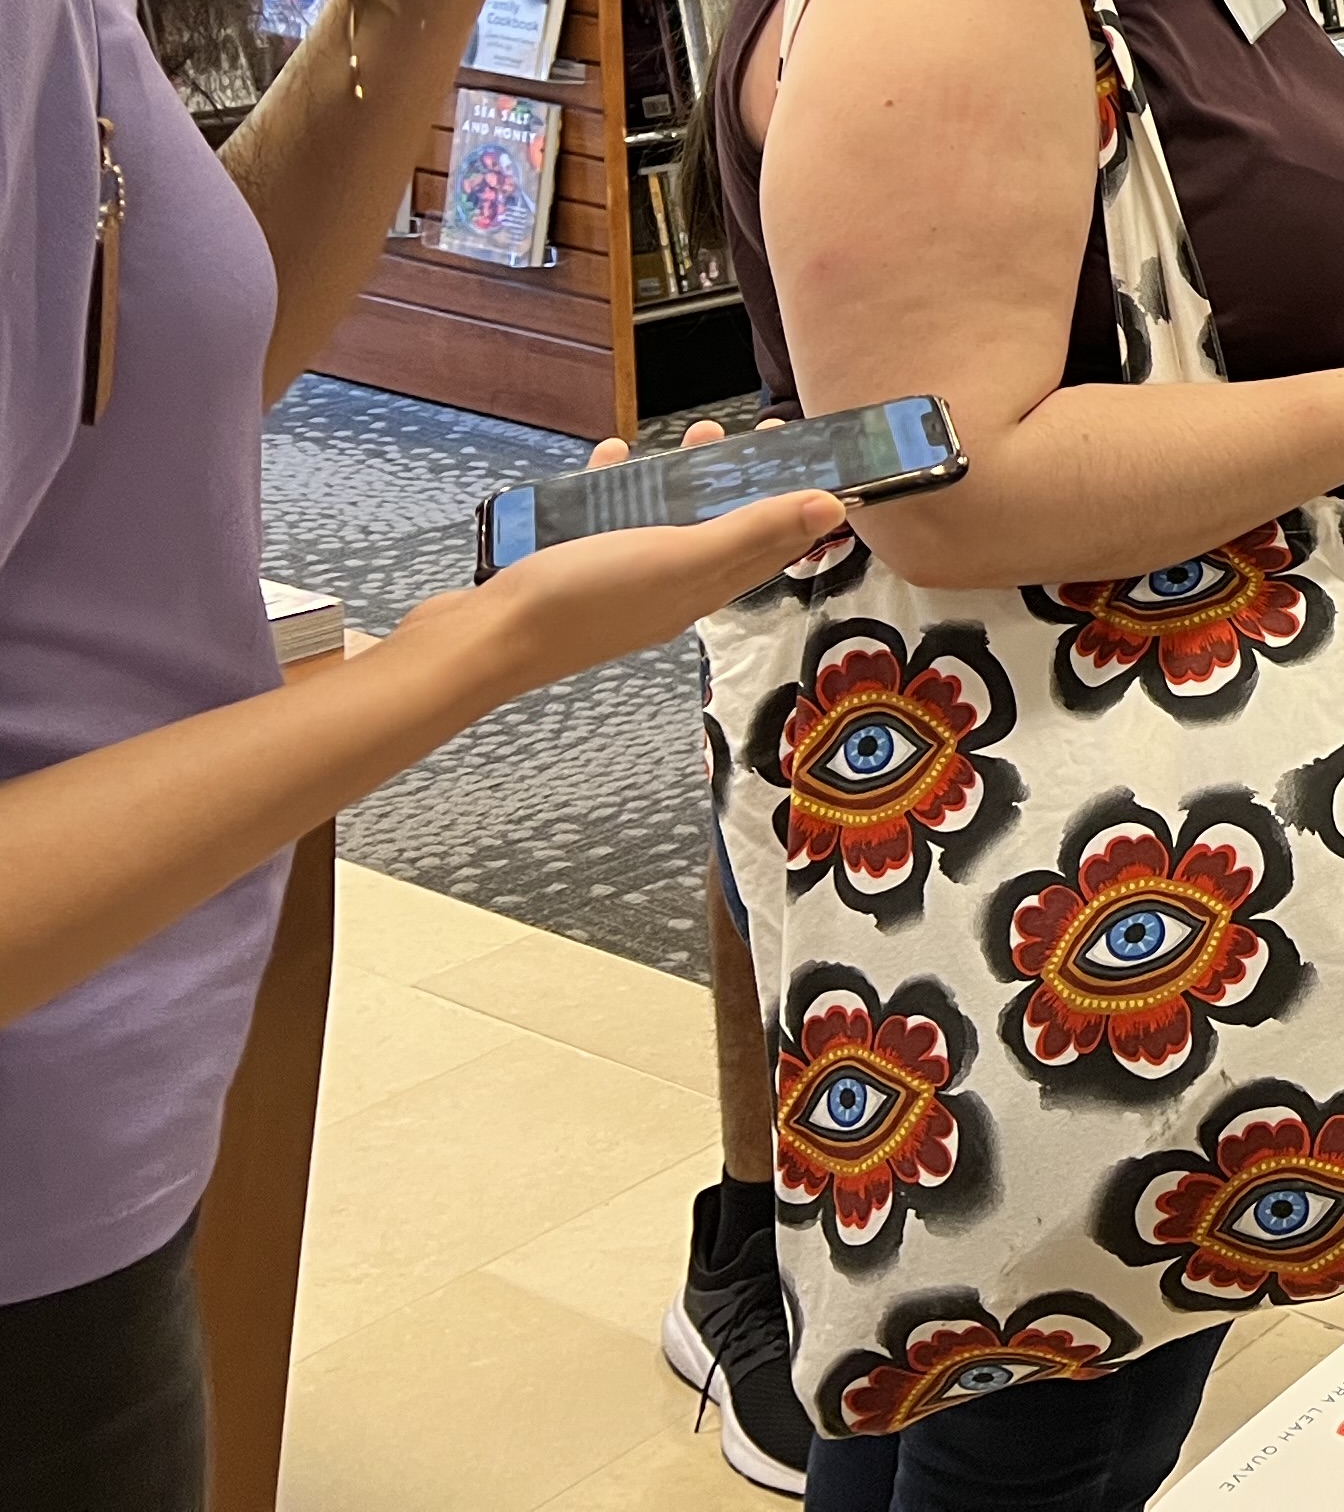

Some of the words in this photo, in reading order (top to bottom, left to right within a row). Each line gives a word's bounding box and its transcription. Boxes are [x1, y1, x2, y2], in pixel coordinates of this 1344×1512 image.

[473, 104, 497, 121] SEA
[500, 108, 531, 126] SALT
[461, 119, 489, 136] AND
[493, 123, 537, 143] HONEY
[1278, 1406, 1323, 1442] LEAH
[1219, 1444, 1278, 1493] QUAVE
